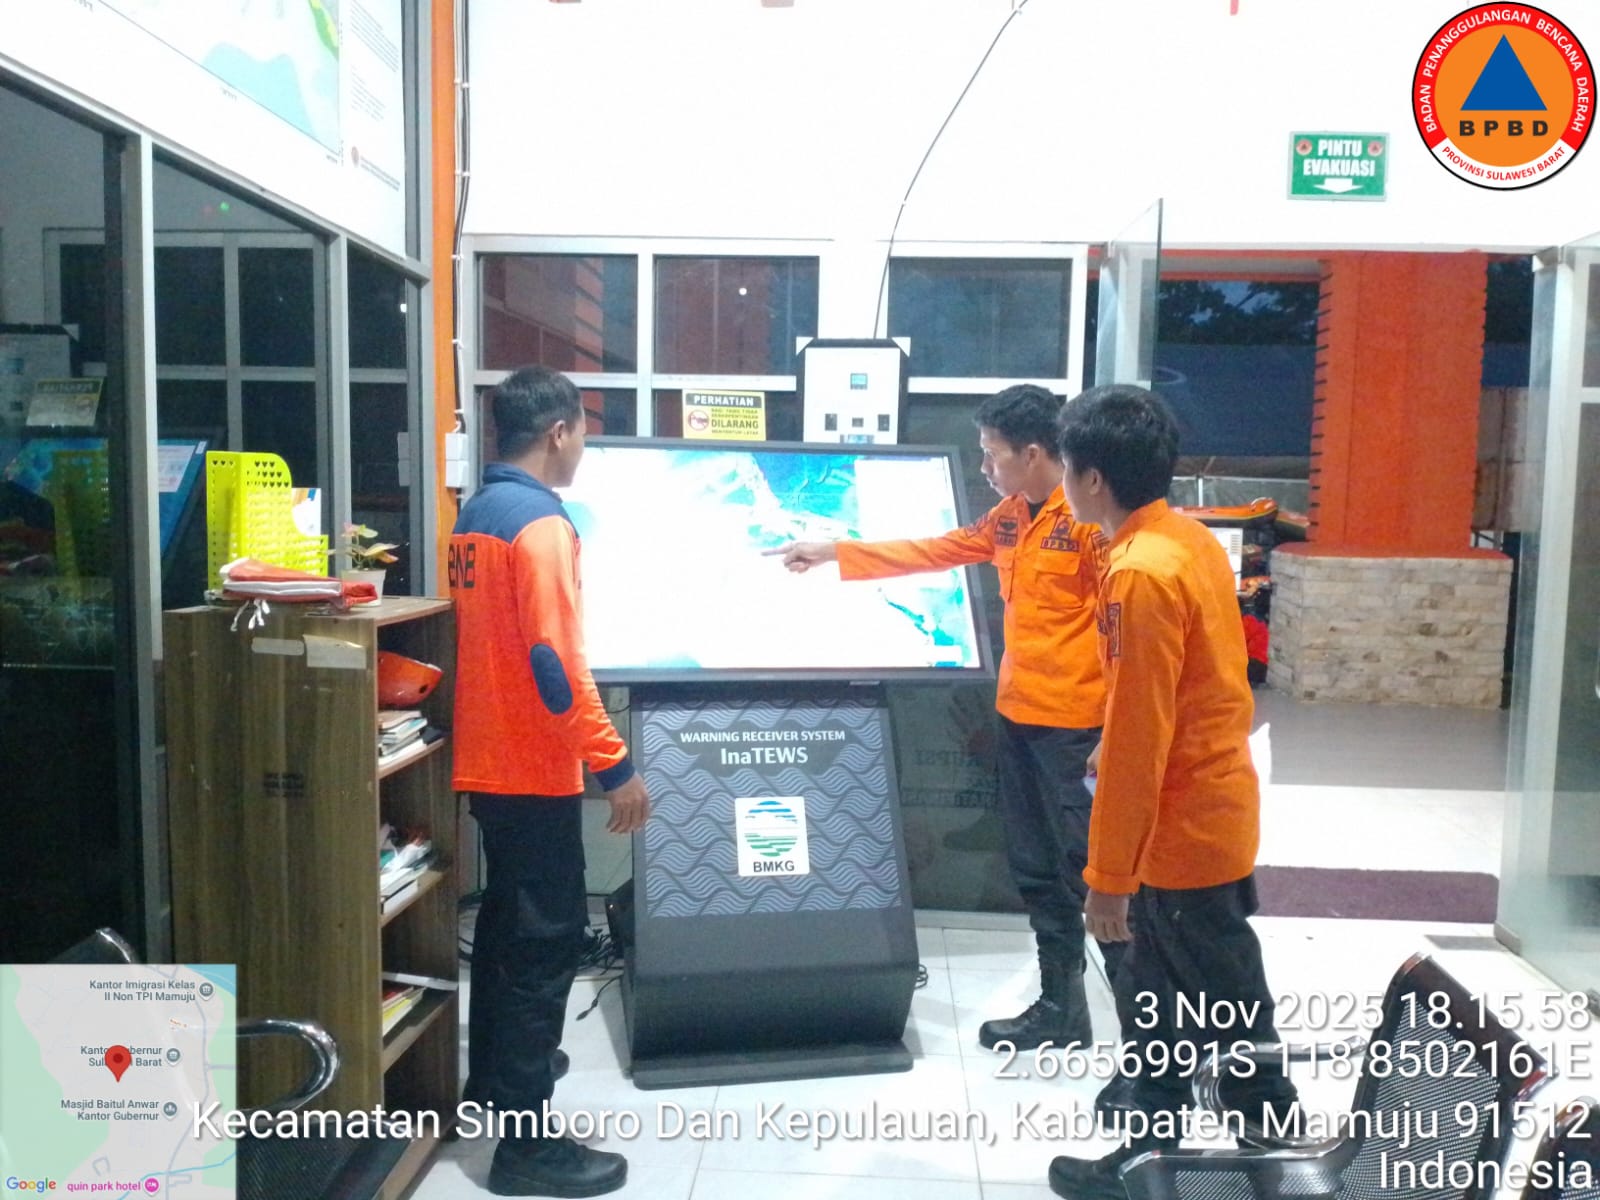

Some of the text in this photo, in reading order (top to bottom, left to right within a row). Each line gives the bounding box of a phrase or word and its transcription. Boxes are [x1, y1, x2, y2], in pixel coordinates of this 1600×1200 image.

[1318, 140, 1362, 156] PINTU
[1303, 159, 1375, 176] EVAKUASI
[693, 395, 754, 406] PERHATIAN
[711, 419, 759, 429] DILARANG
[680, 730, 846, 743] WARNING RECEIVER SYSTEM
[720, 747, 809, 765] InaTEWS
[753, 860, 795, 873] BMKG
